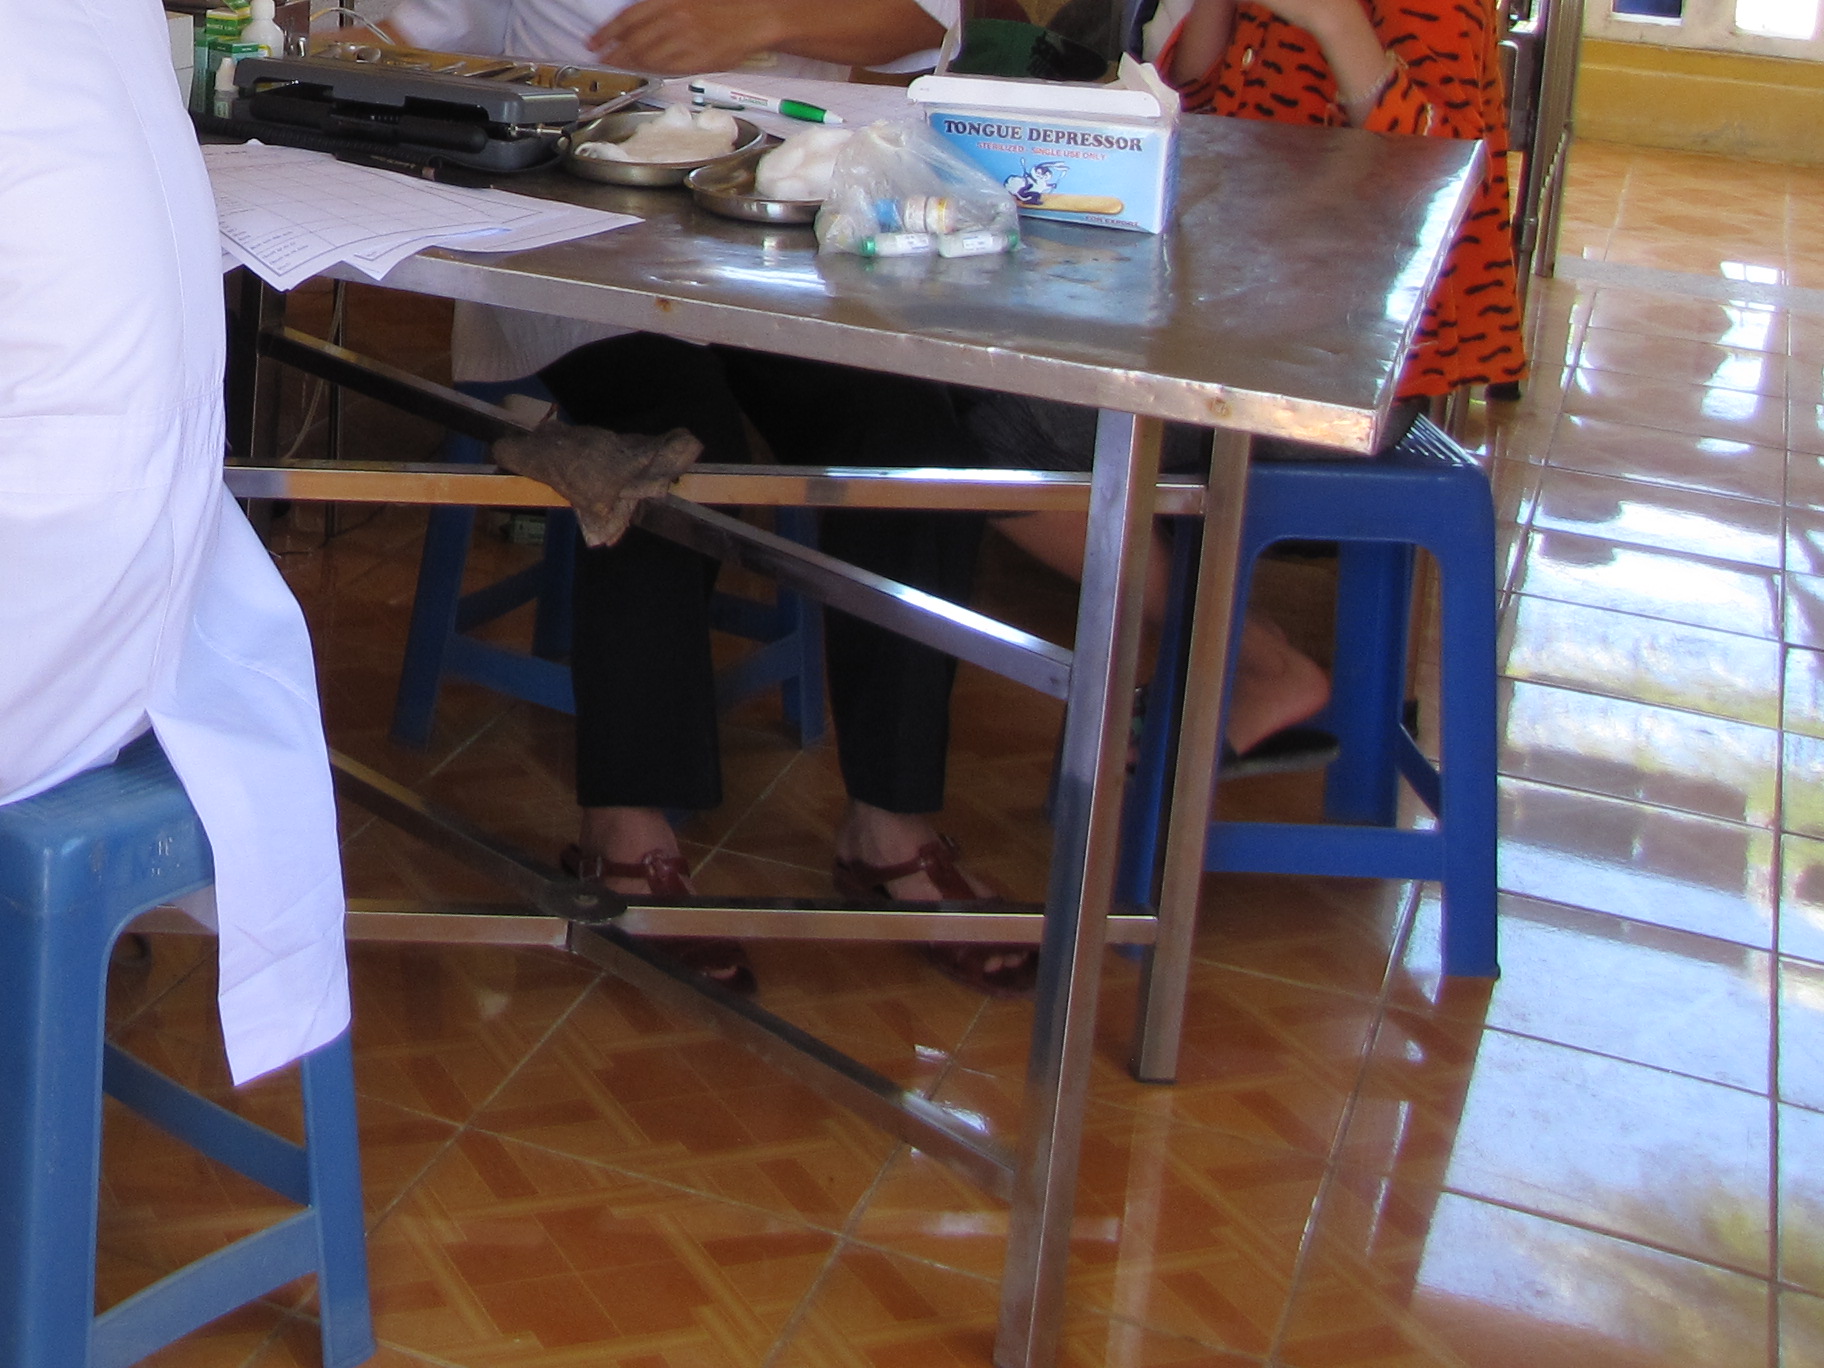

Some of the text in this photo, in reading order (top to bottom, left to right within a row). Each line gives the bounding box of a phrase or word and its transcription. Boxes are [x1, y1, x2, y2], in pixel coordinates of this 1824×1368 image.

[944, 119, 1143, 152] TONGUE DEPRESSOR
[1032, 147, 1060, 157] SINGLE
[1063, 150, 1081, 159] USE
